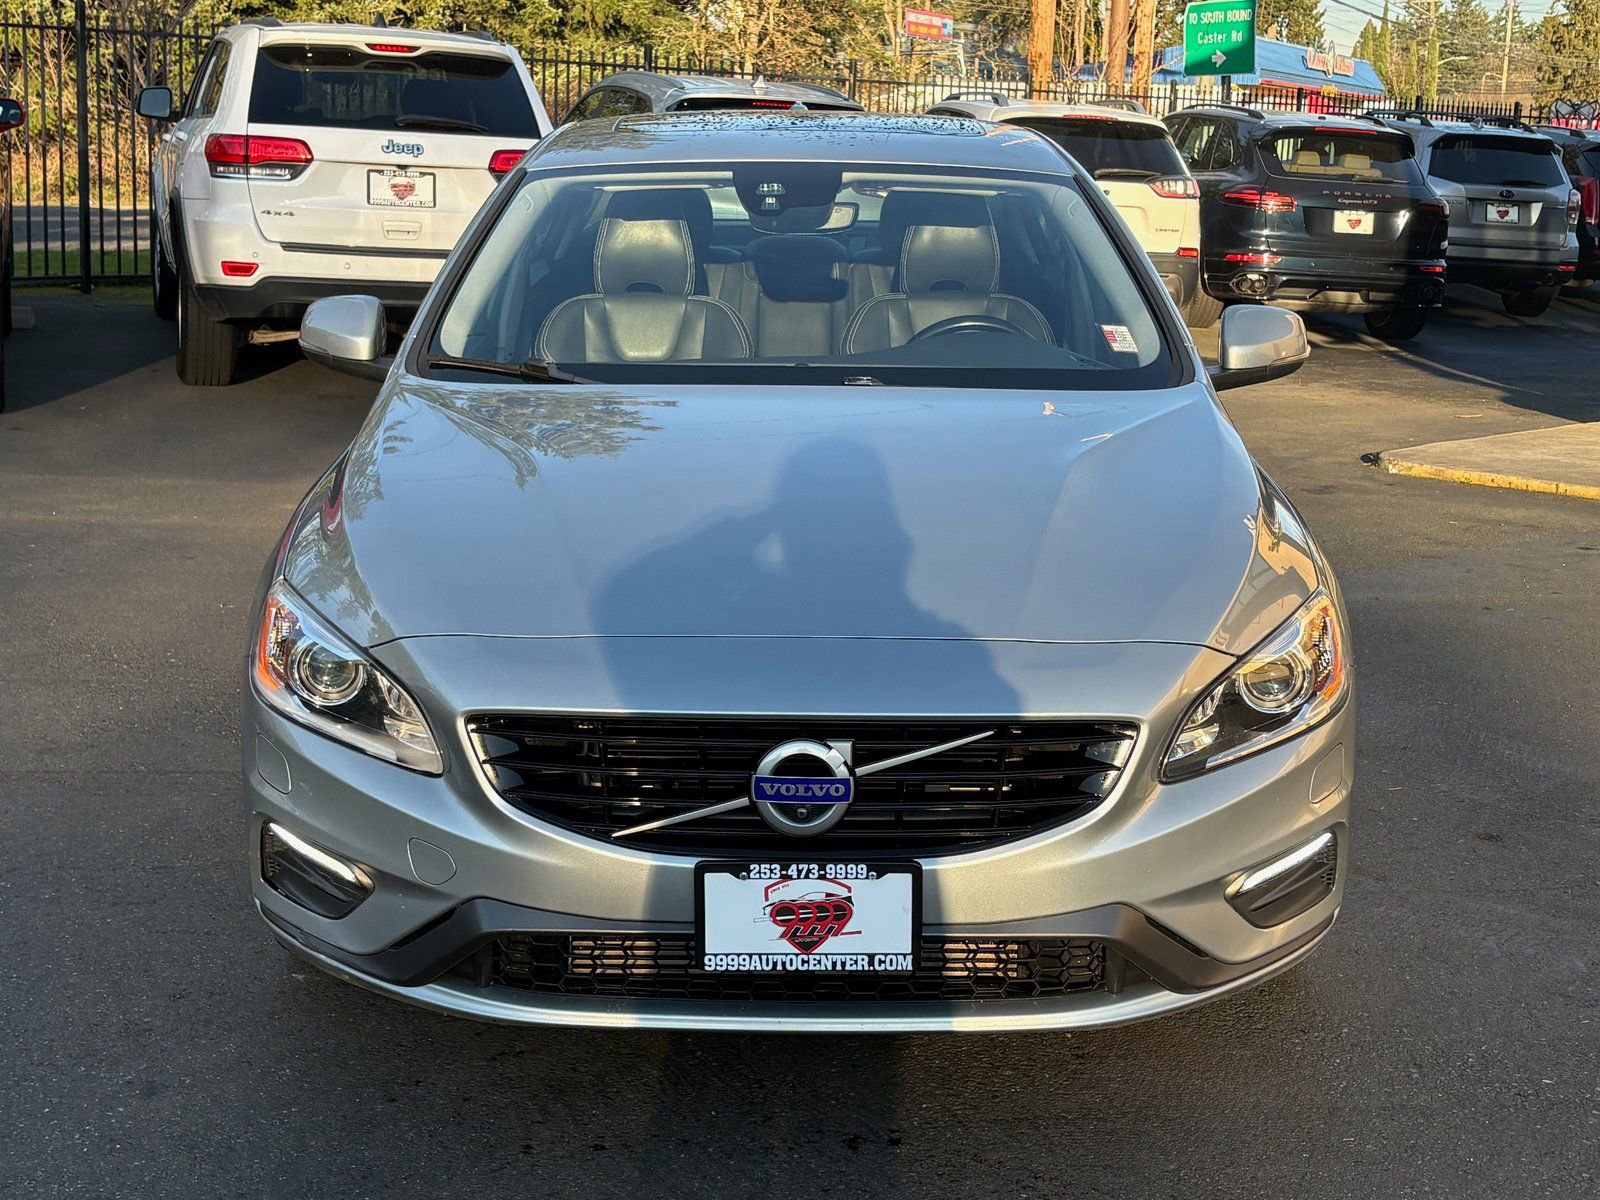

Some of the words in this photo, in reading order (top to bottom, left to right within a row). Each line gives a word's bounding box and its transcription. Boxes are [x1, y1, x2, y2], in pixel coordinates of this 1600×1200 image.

[1189, 12, 1198, 25] TO
[1200, 10, 1224, 24] SOUTH
[1227, 9, 1252, 22] BOUND
[1231, 30, 1243, 43] Rd
[381, 138, 424, 158] Jeep
[760, 782, 846, 797] VOLVO
[749, 863, 868, 880] 253-473-9999
[703, 954, 913, 971] 9999AUTOCENTER.COM
